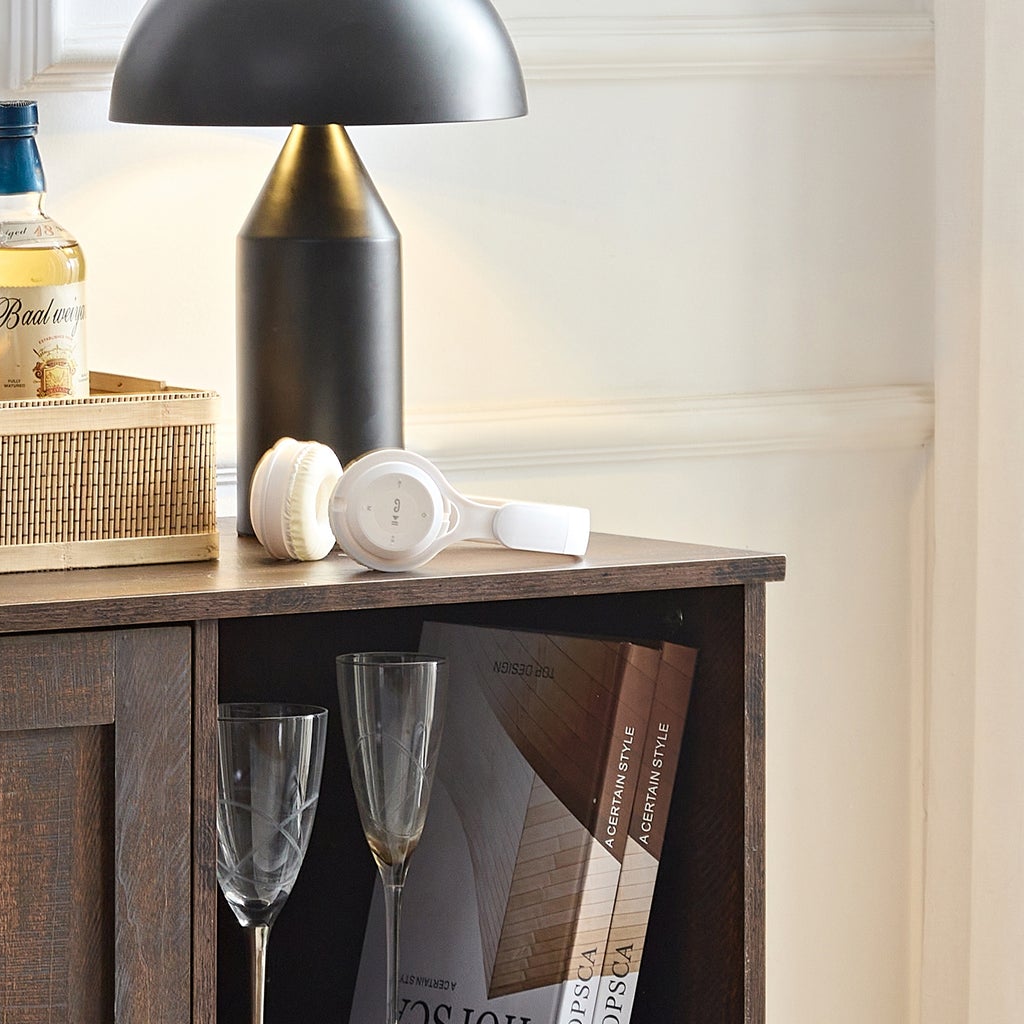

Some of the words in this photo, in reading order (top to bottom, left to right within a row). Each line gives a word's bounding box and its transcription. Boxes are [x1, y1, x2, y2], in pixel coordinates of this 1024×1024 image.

[493, 661, 534, 677] DESIGN
[535, 665, 555, 679] TOP
[618, 725, 635, 772] STYLE
[652, 722, 670, 769] STYLE
[607, 774, 626, 836] CERTAIN
[641, 770, 661, 832] CERTAIN
[605, 838, 615, 849] A
[639, 834, 650, 845] A
[399, 973, 415, 985] STY
[416, 976, 451, 991] CERTAIN
[451, 980, 458, 991] A
